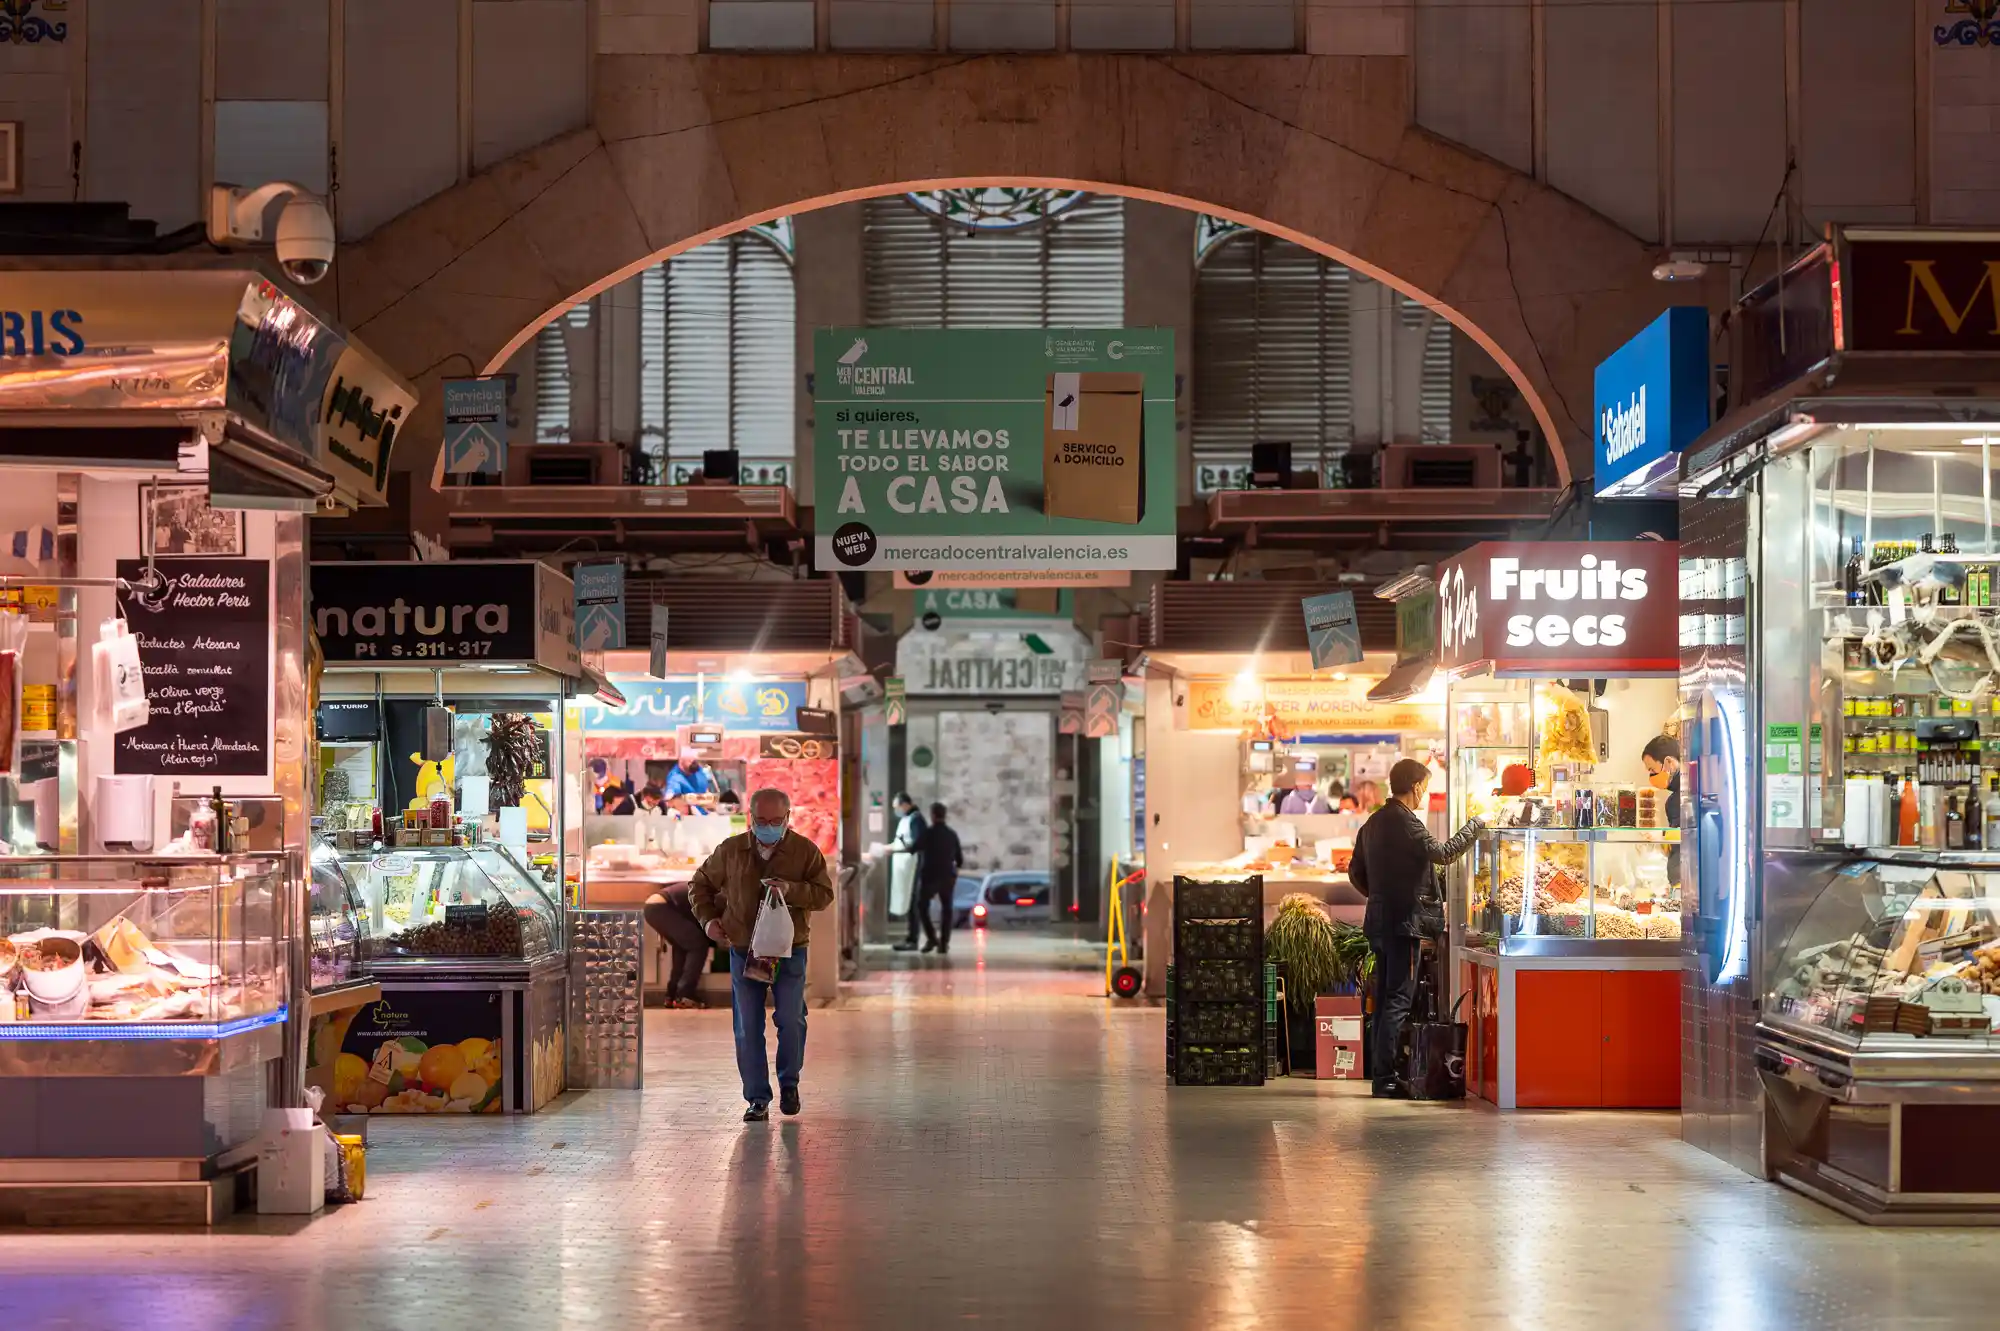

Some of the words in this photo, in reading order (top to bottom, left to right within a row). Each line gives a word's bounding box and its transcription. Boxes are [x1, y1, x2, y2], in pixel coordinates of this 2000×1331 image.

[854, 366, 914, 385] CENTRAL
[447, 389, 493, 401] Servicio
[836, 408, 850, 422] si
[855, 408, 920, 425] quieres,
[1606, 383, 1646, 466] Sabadell
[837, 429, 874, 450] TE
[879, 429, 1010, 450] LLEVAMOS
[1063, 442, 1117, 455] SERVICIO
[837, 455, 899, 472] TODO
[908, 455, 930, 472] EL
[938, 455, 1010, 472] SABOR
[1053, 454, 1061, 464] A
[1064, 454, 1125, 467] DOMICILIO
[837, 475, 866, 514] A
[886, 475, 1010, 514] CASA
[836, 531, 871, 547] NUEVA
[844, 543, 867, 556] WEB
[884, 544, 1128, 561] mercadocentralvalencia.es
[178, 573, 246, 588] Saladures
[581, 573, 609, 585] Servei
[938, 571, 1099, 581] mercadocentralvalencia.es
[1490, 554, 1648, 601] Fruits
[172, 592, 215, 607] Hector
[217, 592, 251, 607] Peris
[925, 592, 937, 609] A
[946, 591, 1001, 609] CASA
[317, 597, 509, 637] natura
[1506, 614, 1627, 647] secs
[136, 631, 186, 649] Productes
[192, 635, 241, 650] Artesans
[187, 664, 233, 675] remullat
[148, 687, 159, 699] de
[160, 685, 192, 698] Oliva
[1307, 700, 1375, 713] MORENO
[381, 1011, 409, 1019] natura
